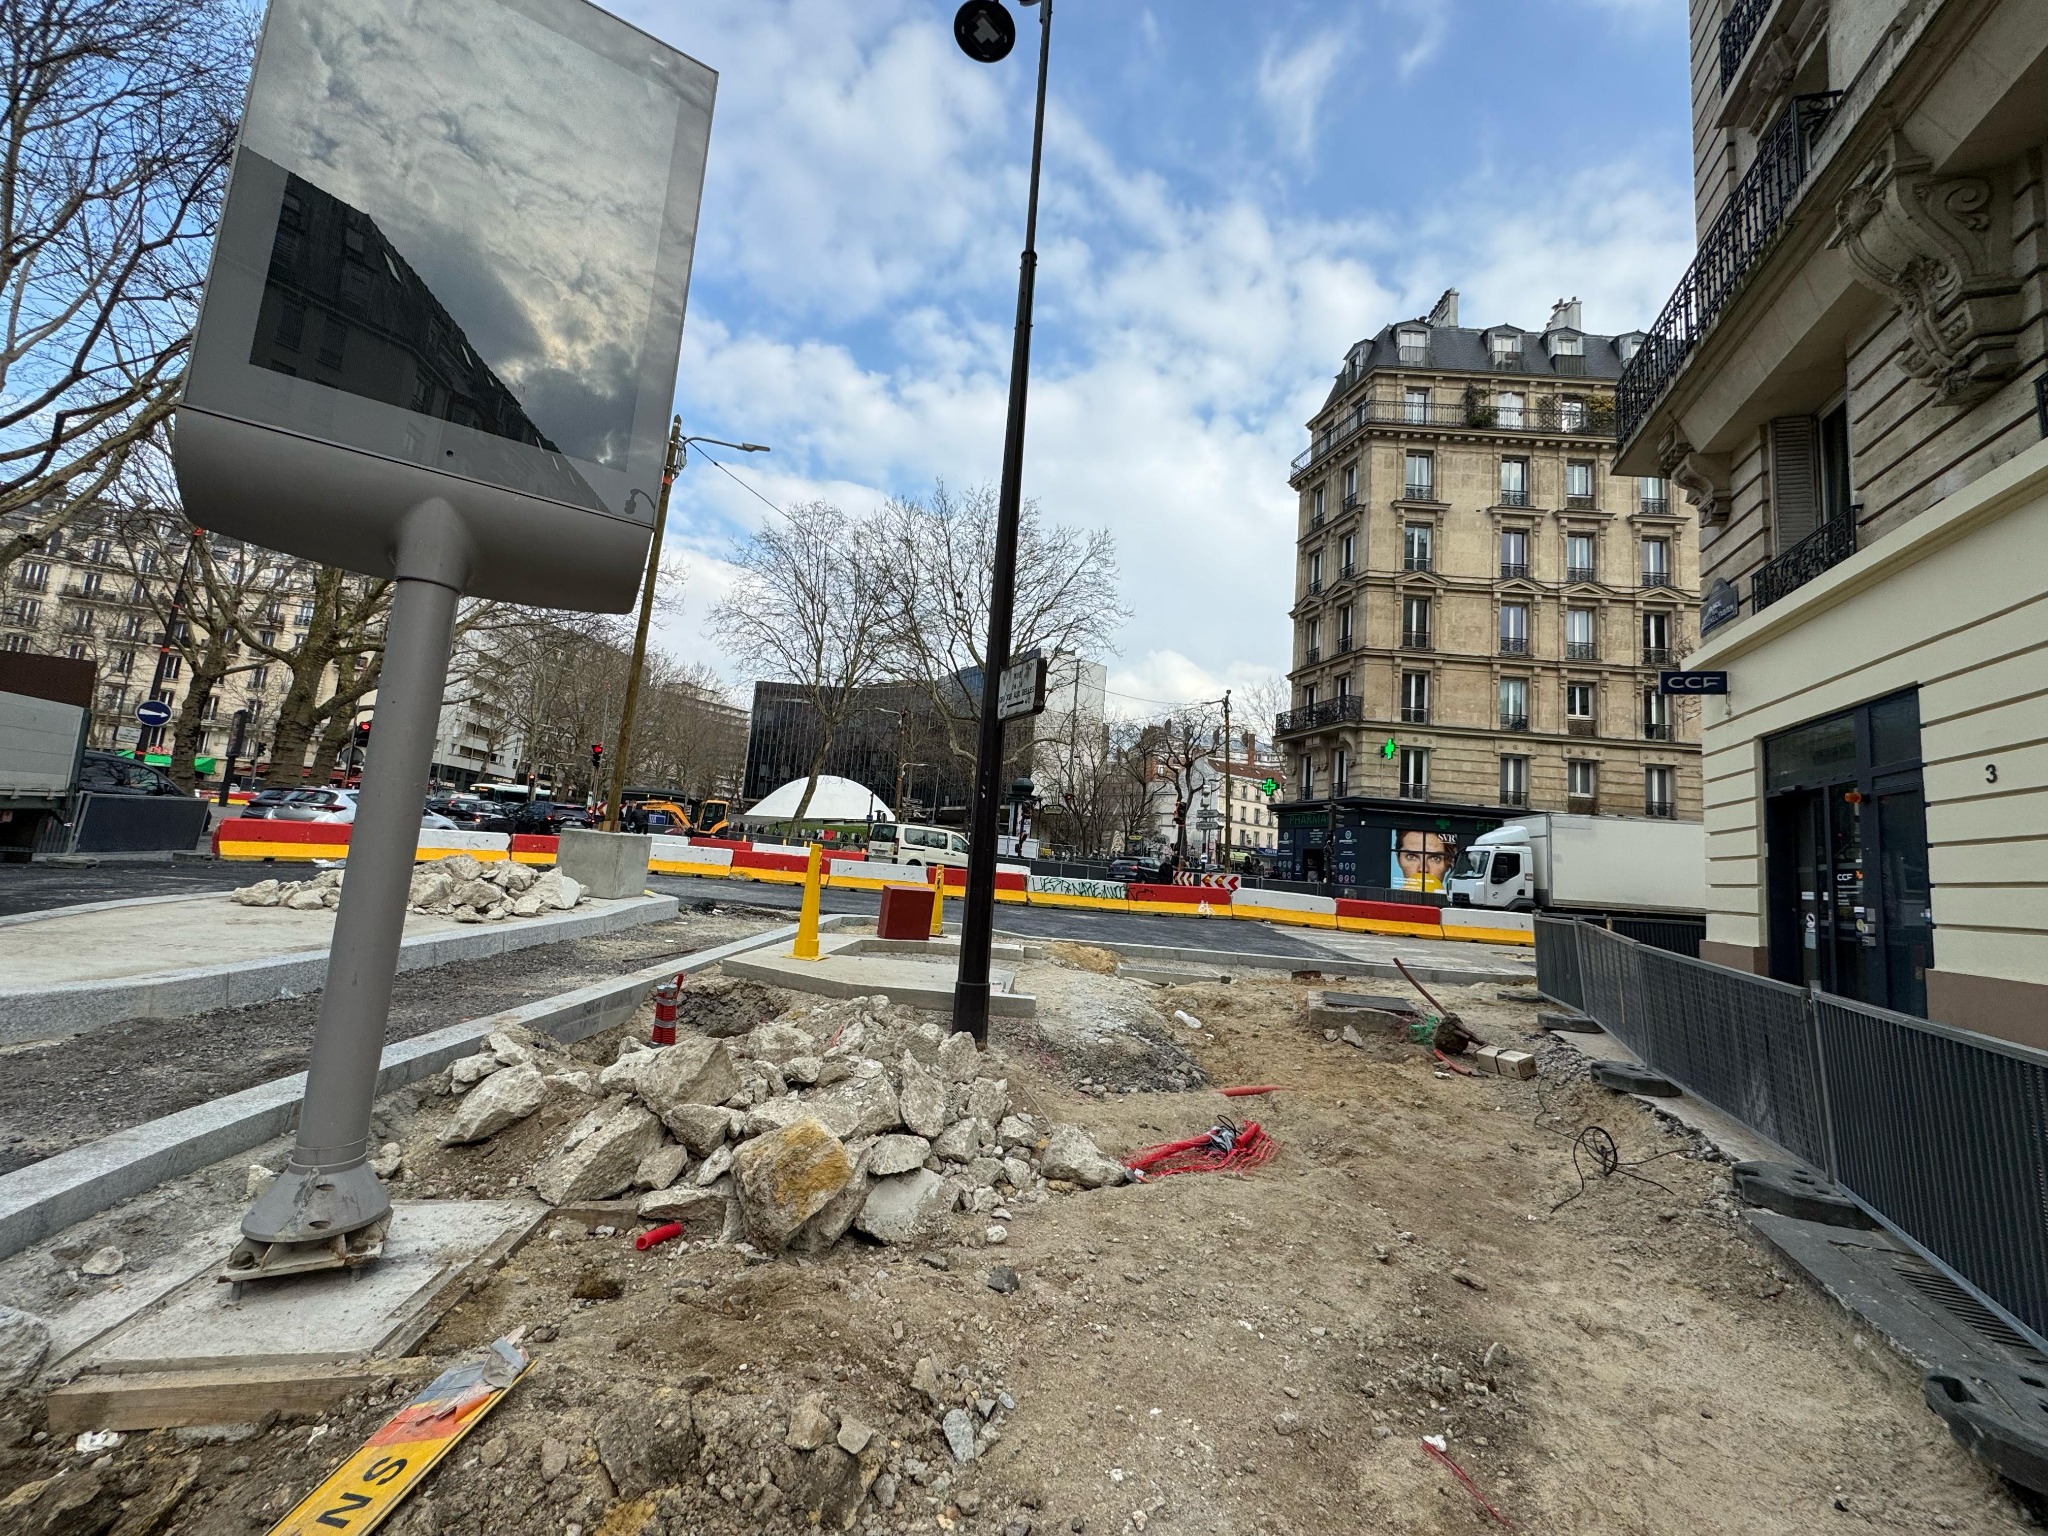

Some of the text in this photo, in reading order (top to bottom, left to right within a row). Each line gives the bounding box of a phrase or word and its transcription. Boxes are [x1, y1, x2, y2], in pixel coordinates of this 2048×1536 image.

[1667, 676, 1721, 689] CCF
[1985, 763, 1998, 784] 3
[1289, 813, 1330, 825] PHARMA
[1438, 833, 1457, 843] SVR
[1837, 873, 1854, 881] CCF
